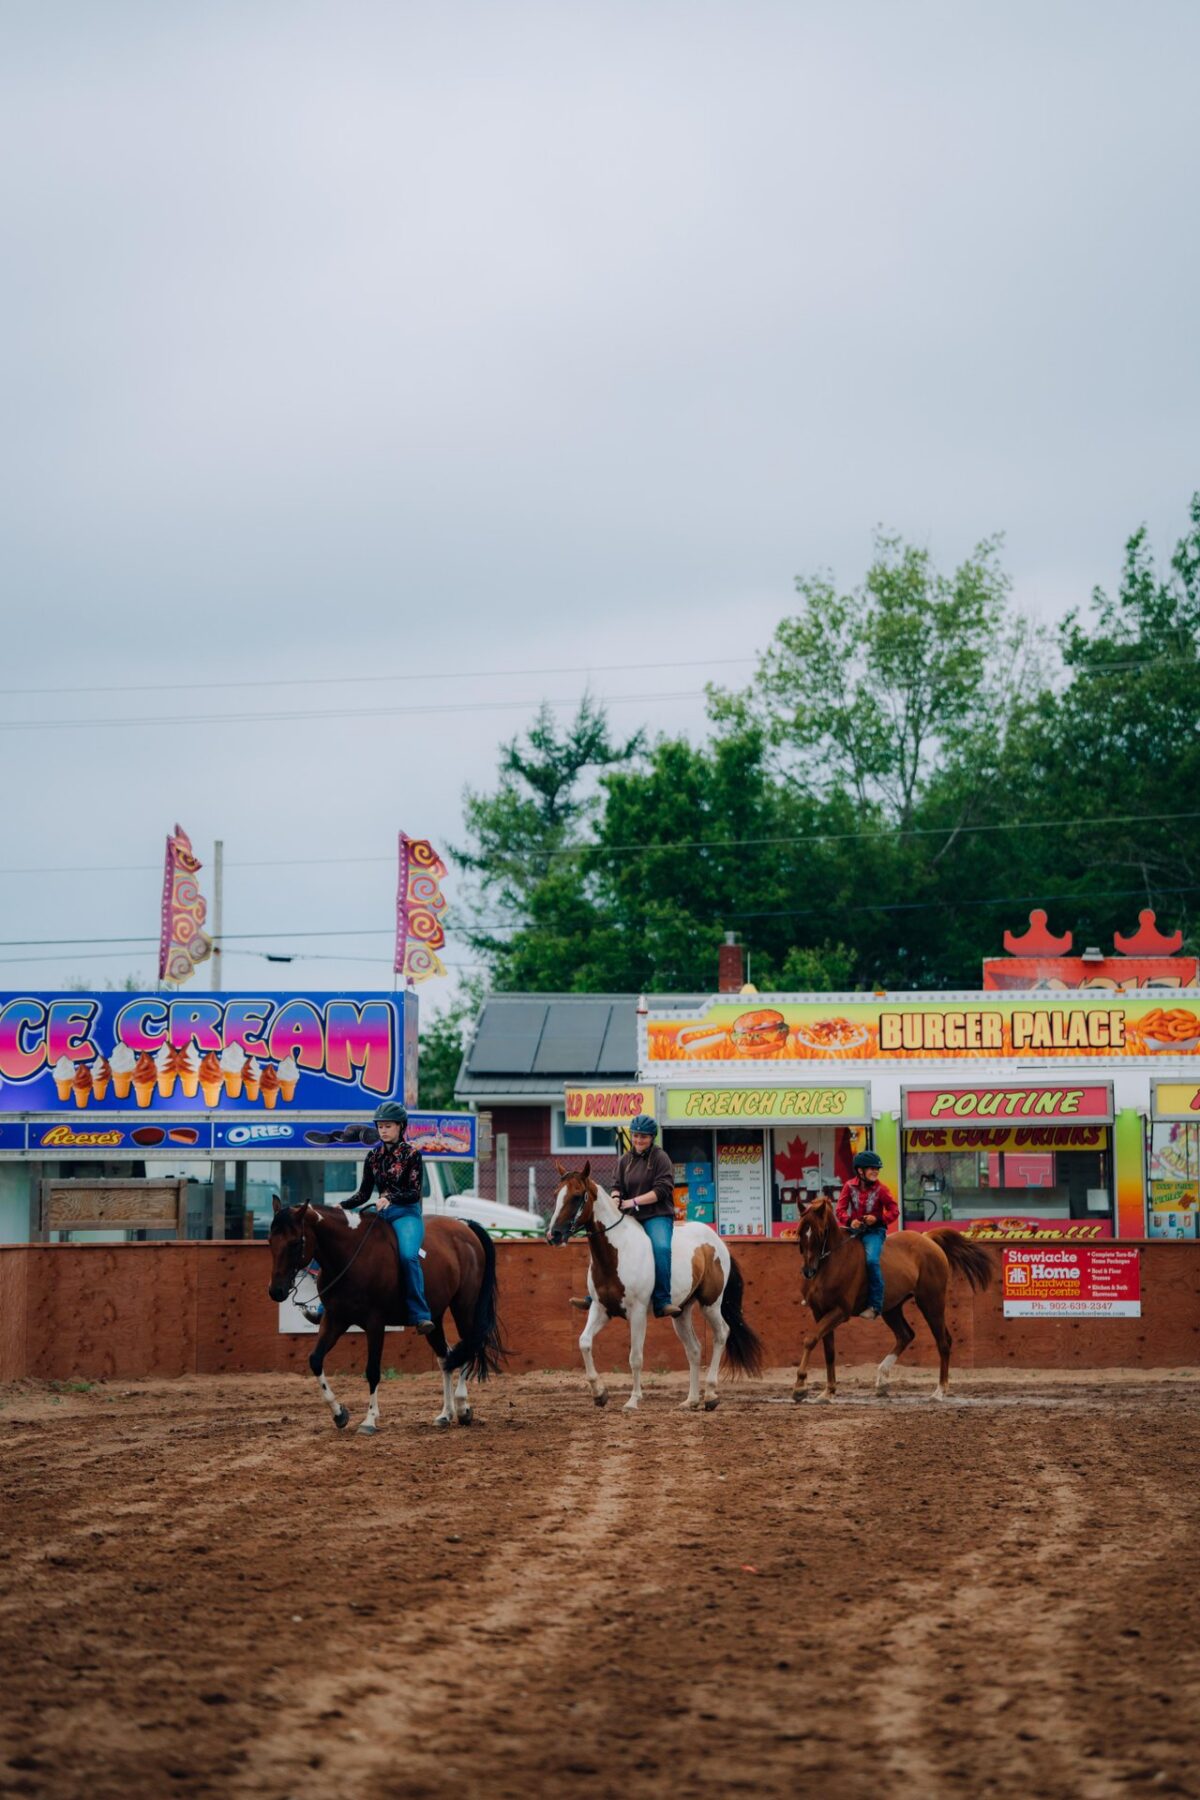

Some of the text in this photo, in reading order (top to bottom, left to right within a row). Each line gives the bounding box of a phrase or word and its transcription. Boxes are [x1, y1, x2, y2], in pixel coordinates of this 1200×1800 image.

[880, 1010, 1126, 1050] BURGER PALACE
[116, 1000, 394, 1097] CREAM
[584, 1092, 644, 1117] DRINKS
[685, 1091, 847, 1116] FRENCH FRIES
[930, 1090, 1084, 1118] POUTINE
[41, 1125, 125, 1147] Reese's
[227, 1124, 294, 1144] OREO
[910, 1126, 1102, 1148] ICE COLD DRINKS
[719, 1153, 761, 1165] MENU
[721, 1145, 762, 1154] COMBO
[1008, 1250, 1078, 1263] Stewiacke
[1031, 1264, 1081, 1279] Home
[1006, 1287, 1081, 1298] building centre
[1031, 1279, 1081, 1288] hardware
[1031, 1302, 1046, 1310] Ph.
